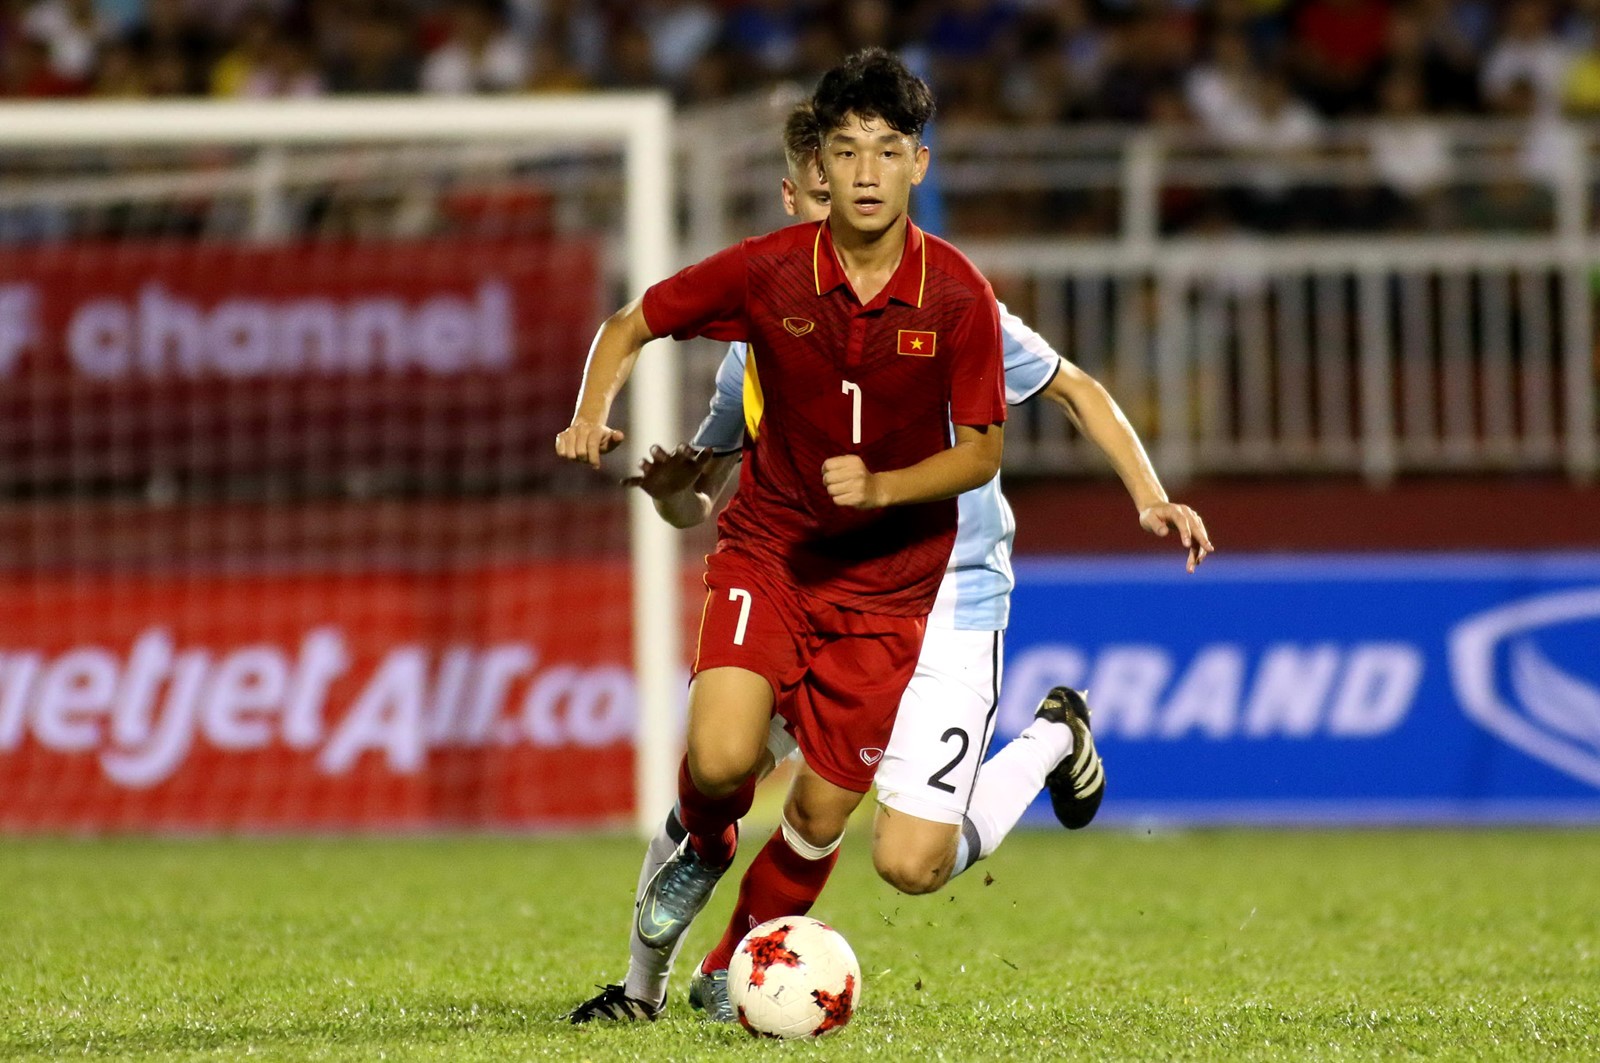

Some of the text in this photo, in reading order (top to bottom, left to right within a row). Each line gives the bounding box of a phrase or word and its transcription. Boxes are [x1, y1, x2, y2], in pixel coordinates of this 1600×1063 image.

[66, 281, 514, 377] channel
[842, 380, 861, 443] 7
[728, 588, 752, 645] 7
[926, 727, 969, 794] 2
